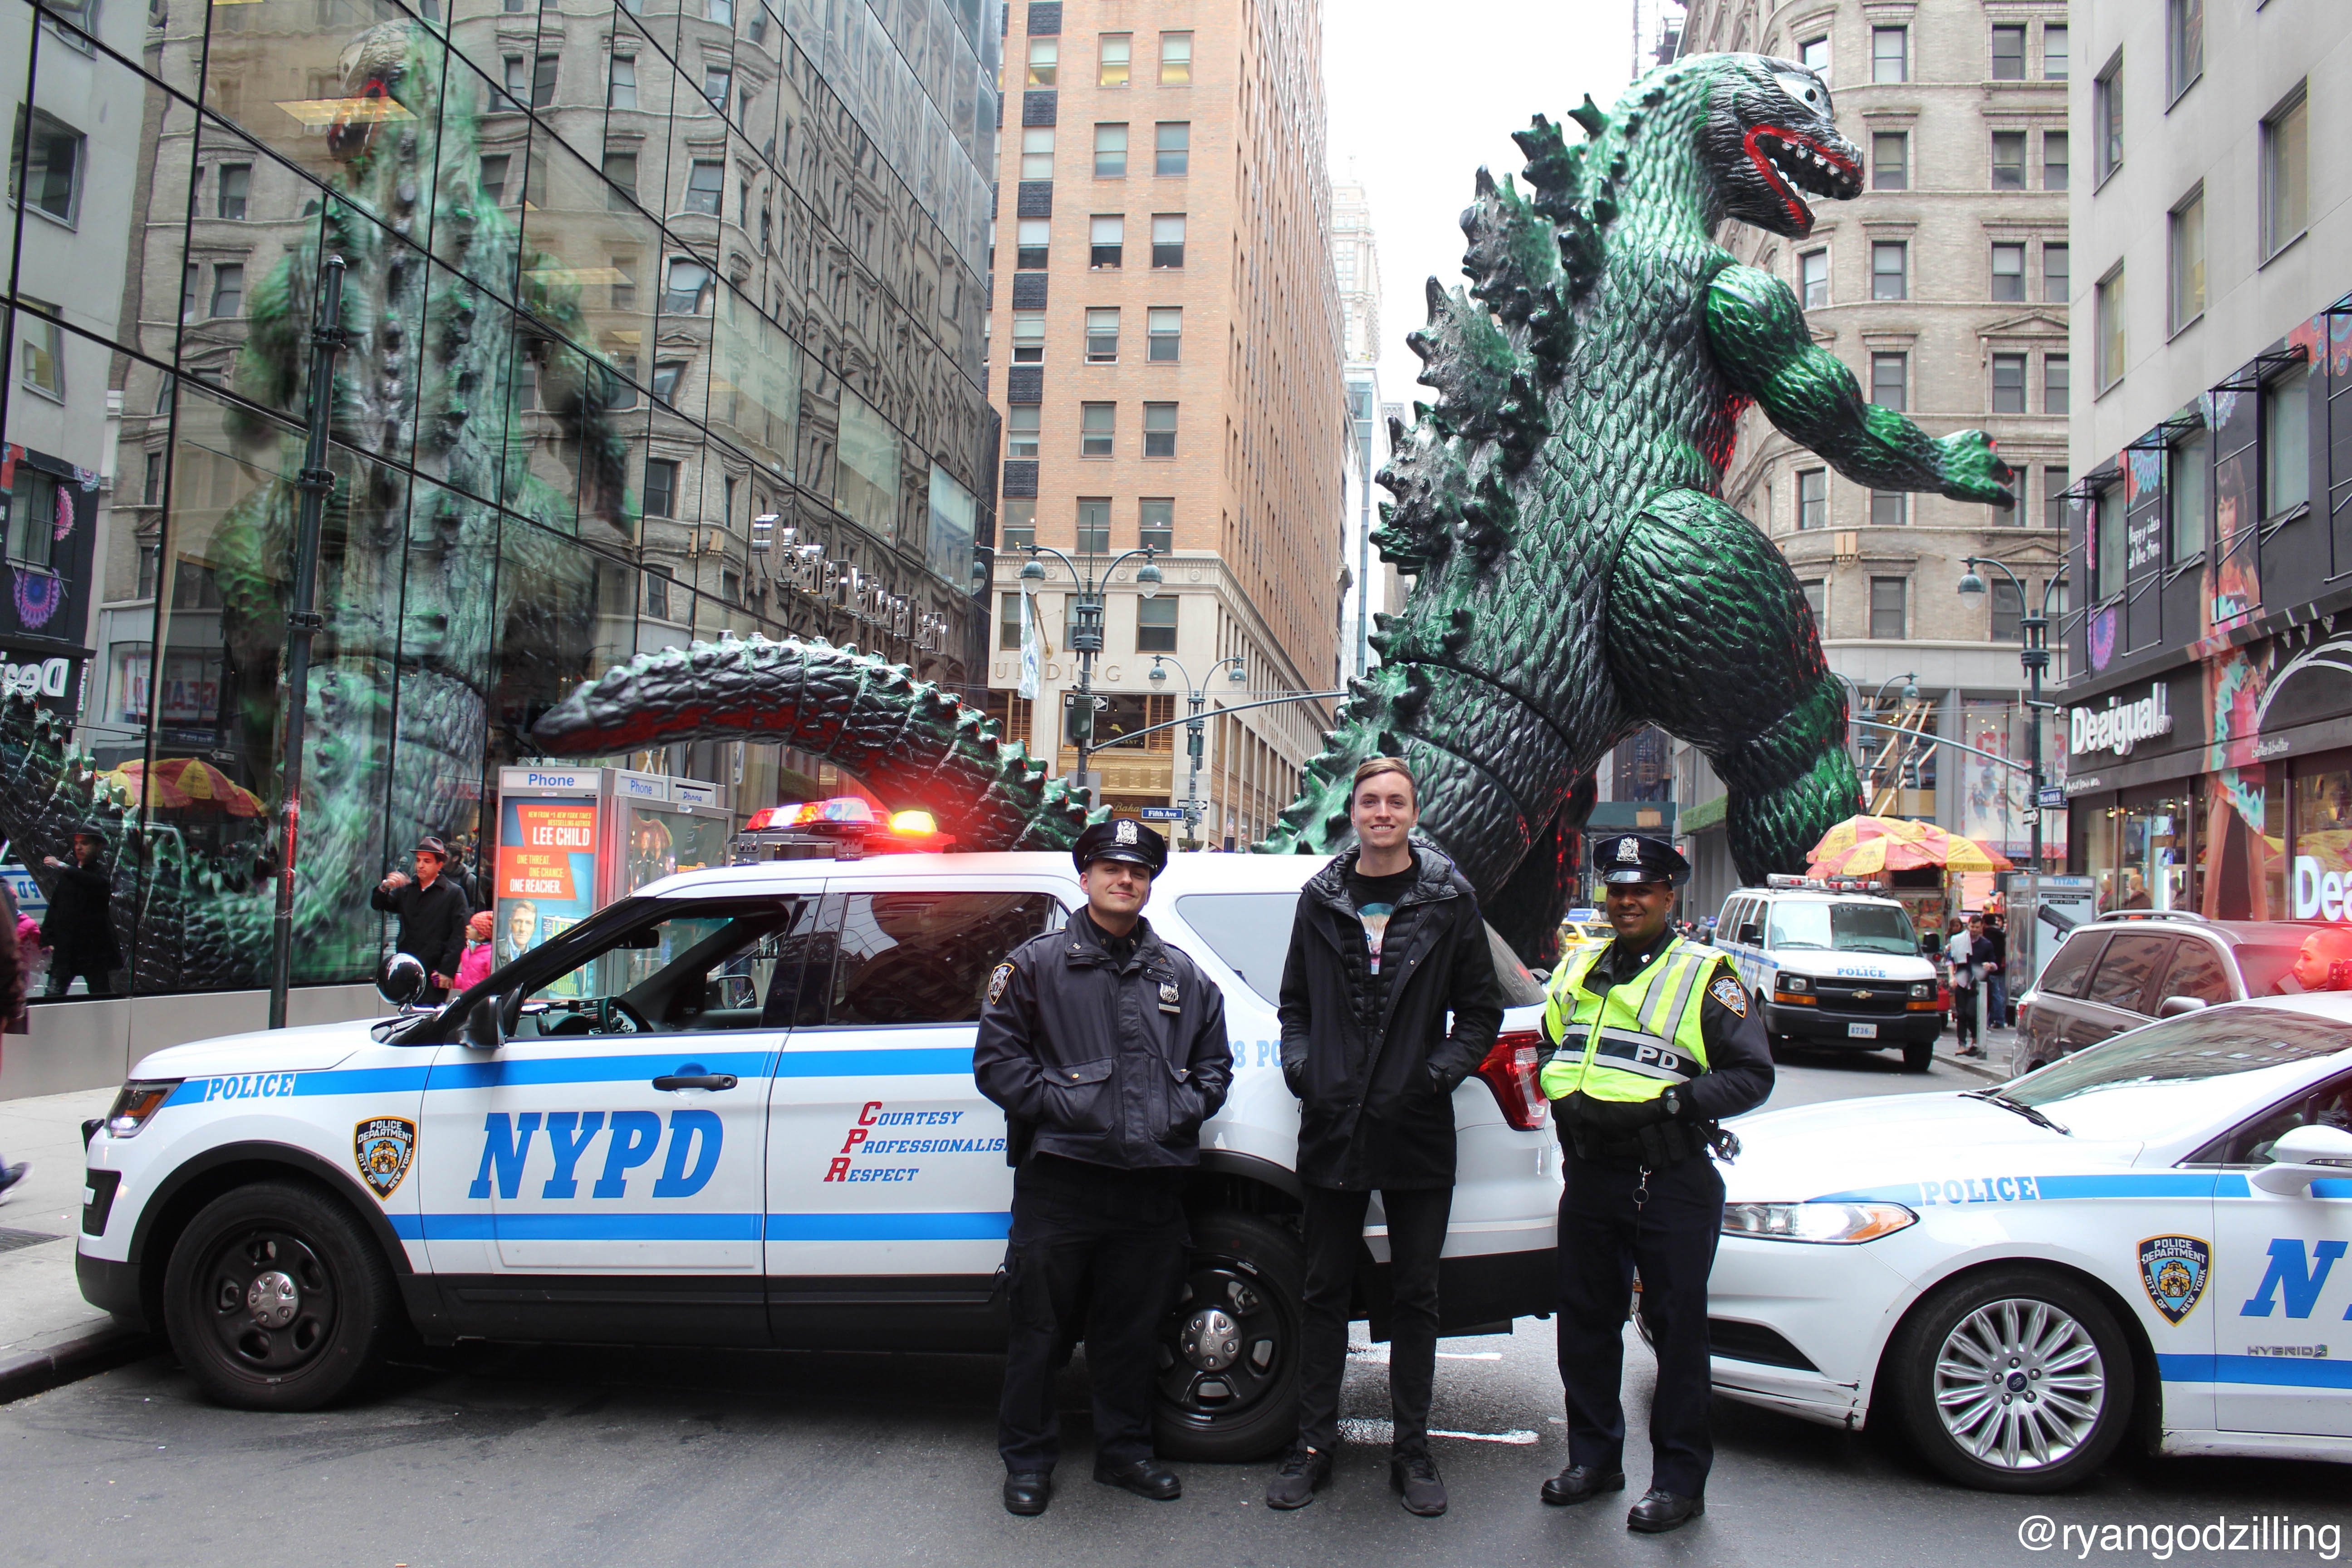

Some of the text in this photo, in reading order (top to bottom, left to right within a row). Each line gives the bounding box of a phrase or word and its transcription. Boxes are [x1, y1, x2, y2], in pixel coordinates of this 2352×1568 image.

[529, 774, 574, 786] Phone
[631, 779, 652, 794] Phone
[532, 827, 590, 847] LEE CHILD
[517, 854, 551, 865] ONE THREAT.
[529, 867, 565, 878] ONE CHANCE.
[510, 878, 562, 893] ONE REACHER.
[1837, 968, 1886, 978] POLICE
[1634, 1044, 1679, 1070] PD
[207, 1073, 295, 1102] POLICE
[370, 1120, 402, 1131] POLICE
[358, 1128, 413, 1144] DEPARTMENT
[840, 1129, 1007, 1154] PROFESSIONALIS
[468, 1110, 724, 1199] NYPD
[358, 1152, 377, 1185] CITY OF
[388, 1147, 413, 1189] NEW YORK
[1921, 1176, 2037, 1205] POLICE
[2154, 1238, 2193, 1250] POLICE
[2141, 1247, 2206, 1265] DEPARTMENT
[2145, 1275, 2167, 1309] CITY OF
[2179, 1269, 2207, 1313] NEW YORK
[2247, 1345, 2313, 1356] HYBRID
